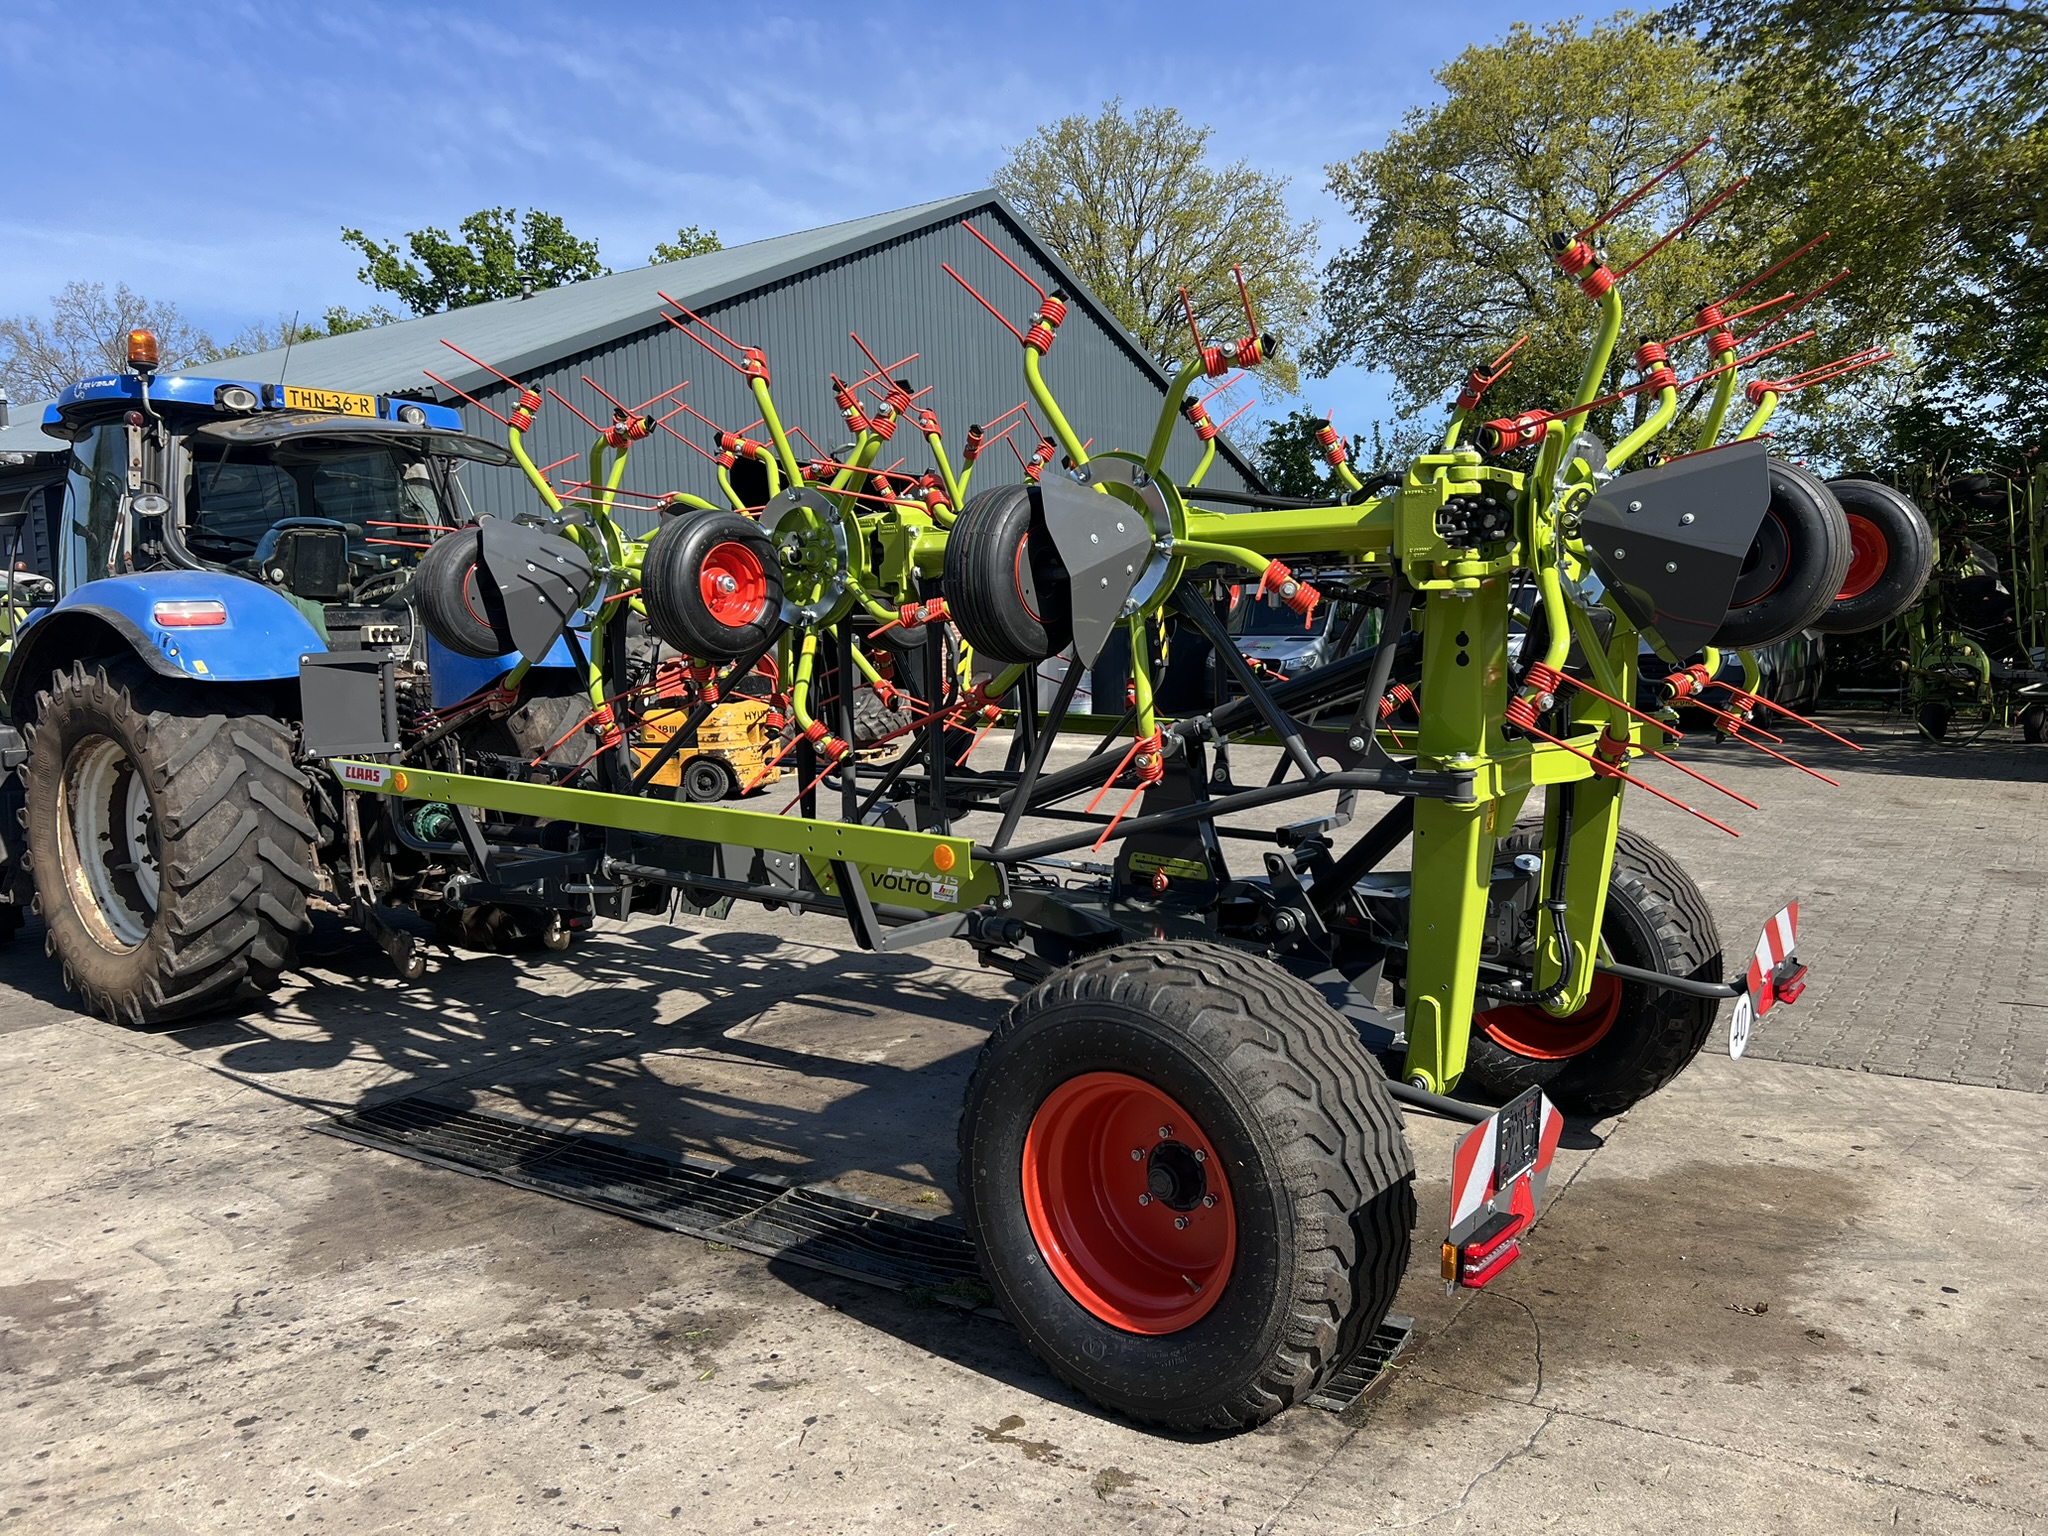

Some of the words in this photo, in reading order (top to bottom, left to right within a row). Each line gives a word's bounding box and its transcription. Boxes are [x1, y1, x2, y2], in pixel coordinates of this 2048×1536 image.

[289, 390, 370, 413] THN-36-R
[345, 765, 380, 782] CLAAS
[871, 872, 931, 895] VOLTO
[1733, 1003, 1747, 1047] 40
